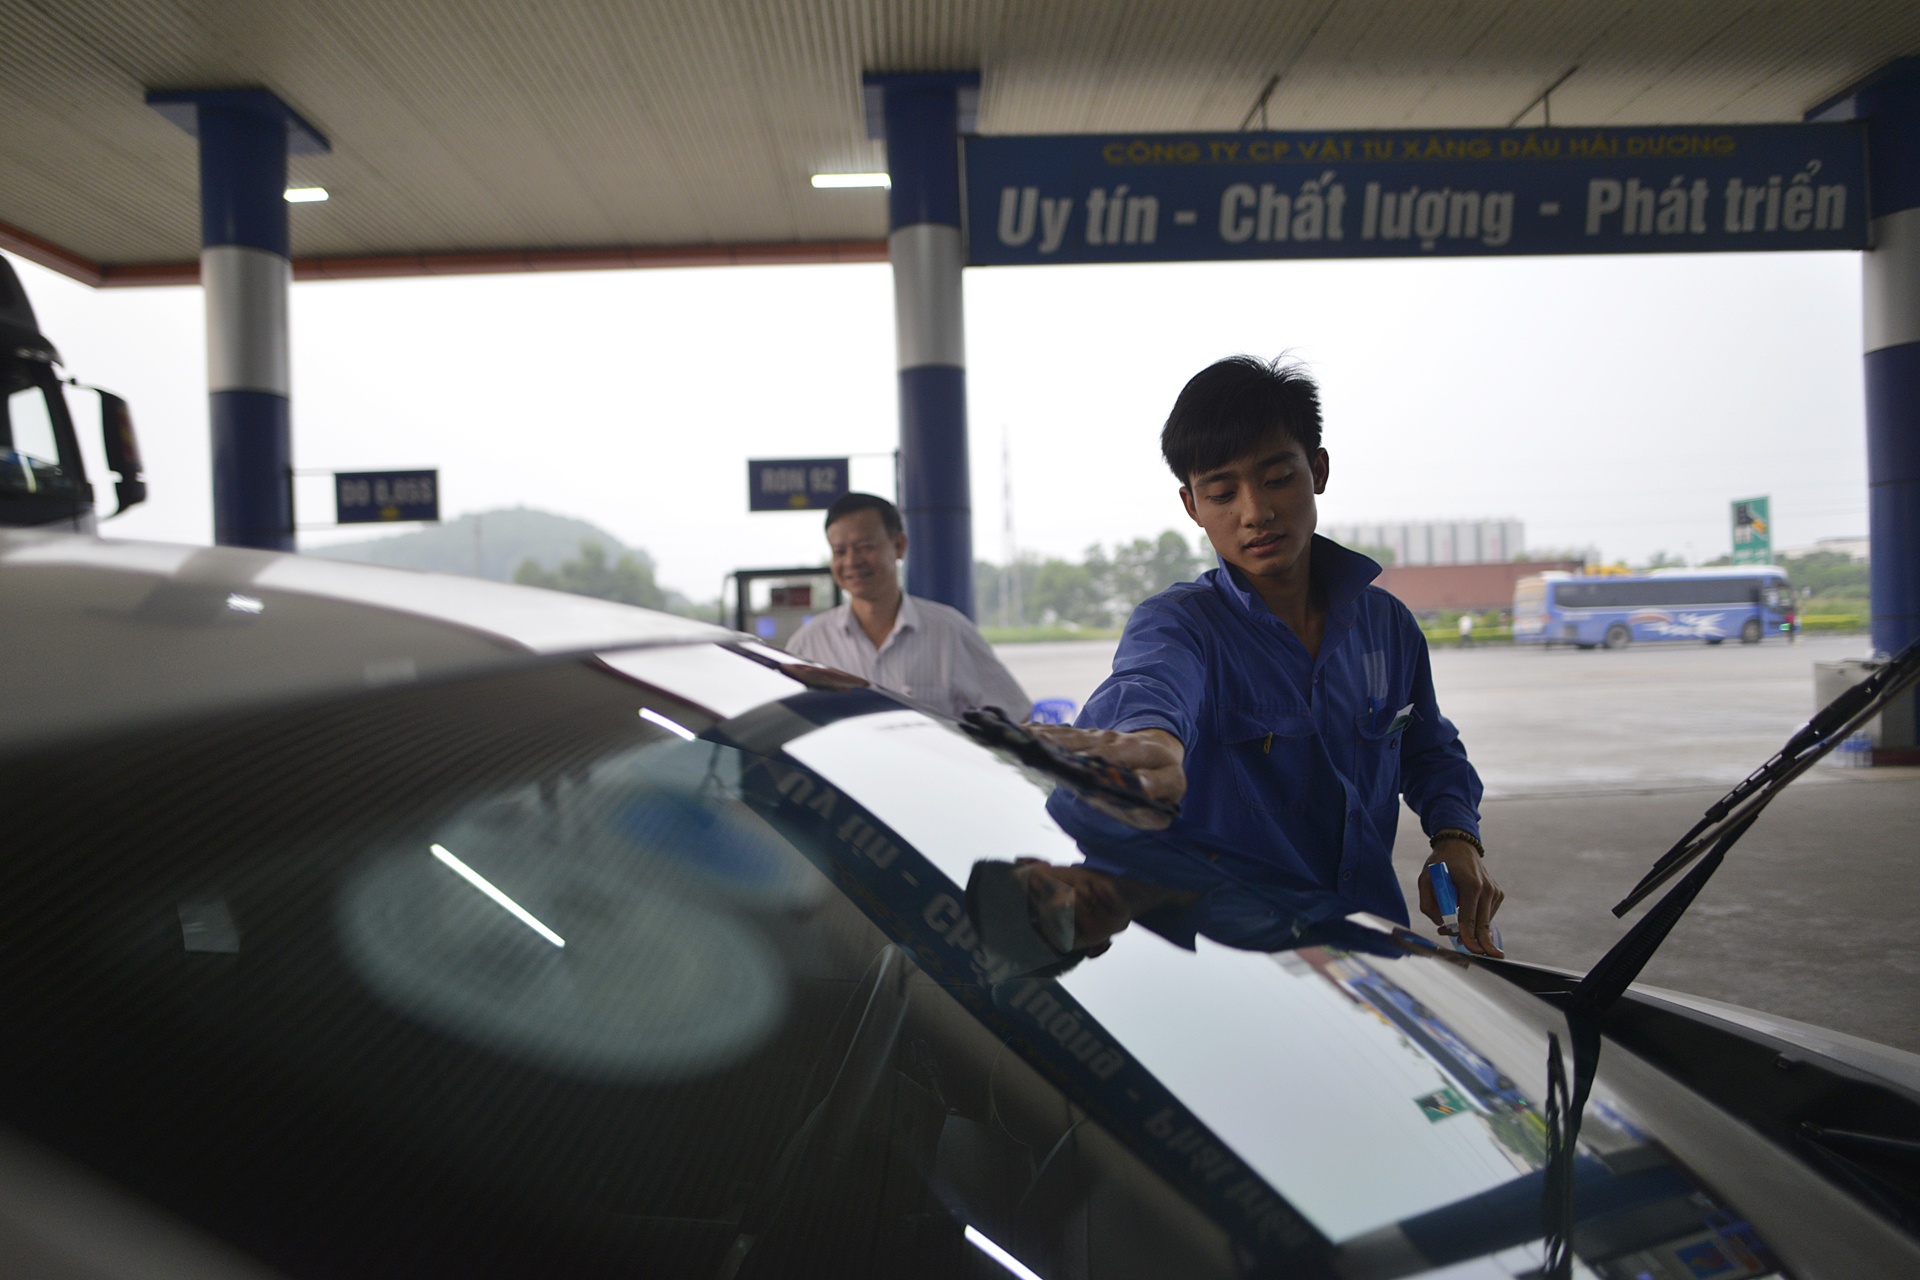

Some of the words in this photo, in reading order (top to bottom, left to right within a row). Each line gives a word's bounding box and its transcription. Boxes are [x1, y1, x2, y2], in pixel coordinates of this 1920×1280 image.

[1209, 139, 1240, 162] TY
[1249, 138, 1291, 162] CP
[997, 185, 1072, 254] Uy
[1085, 183, 1160, 245] tín
[1218, 169, 1348, 244] Chất
[1361, 181, 1515, 251] lượng
[1585, 175, 1710, 236] Phát
[1723, 158, 1847, 234] triển
